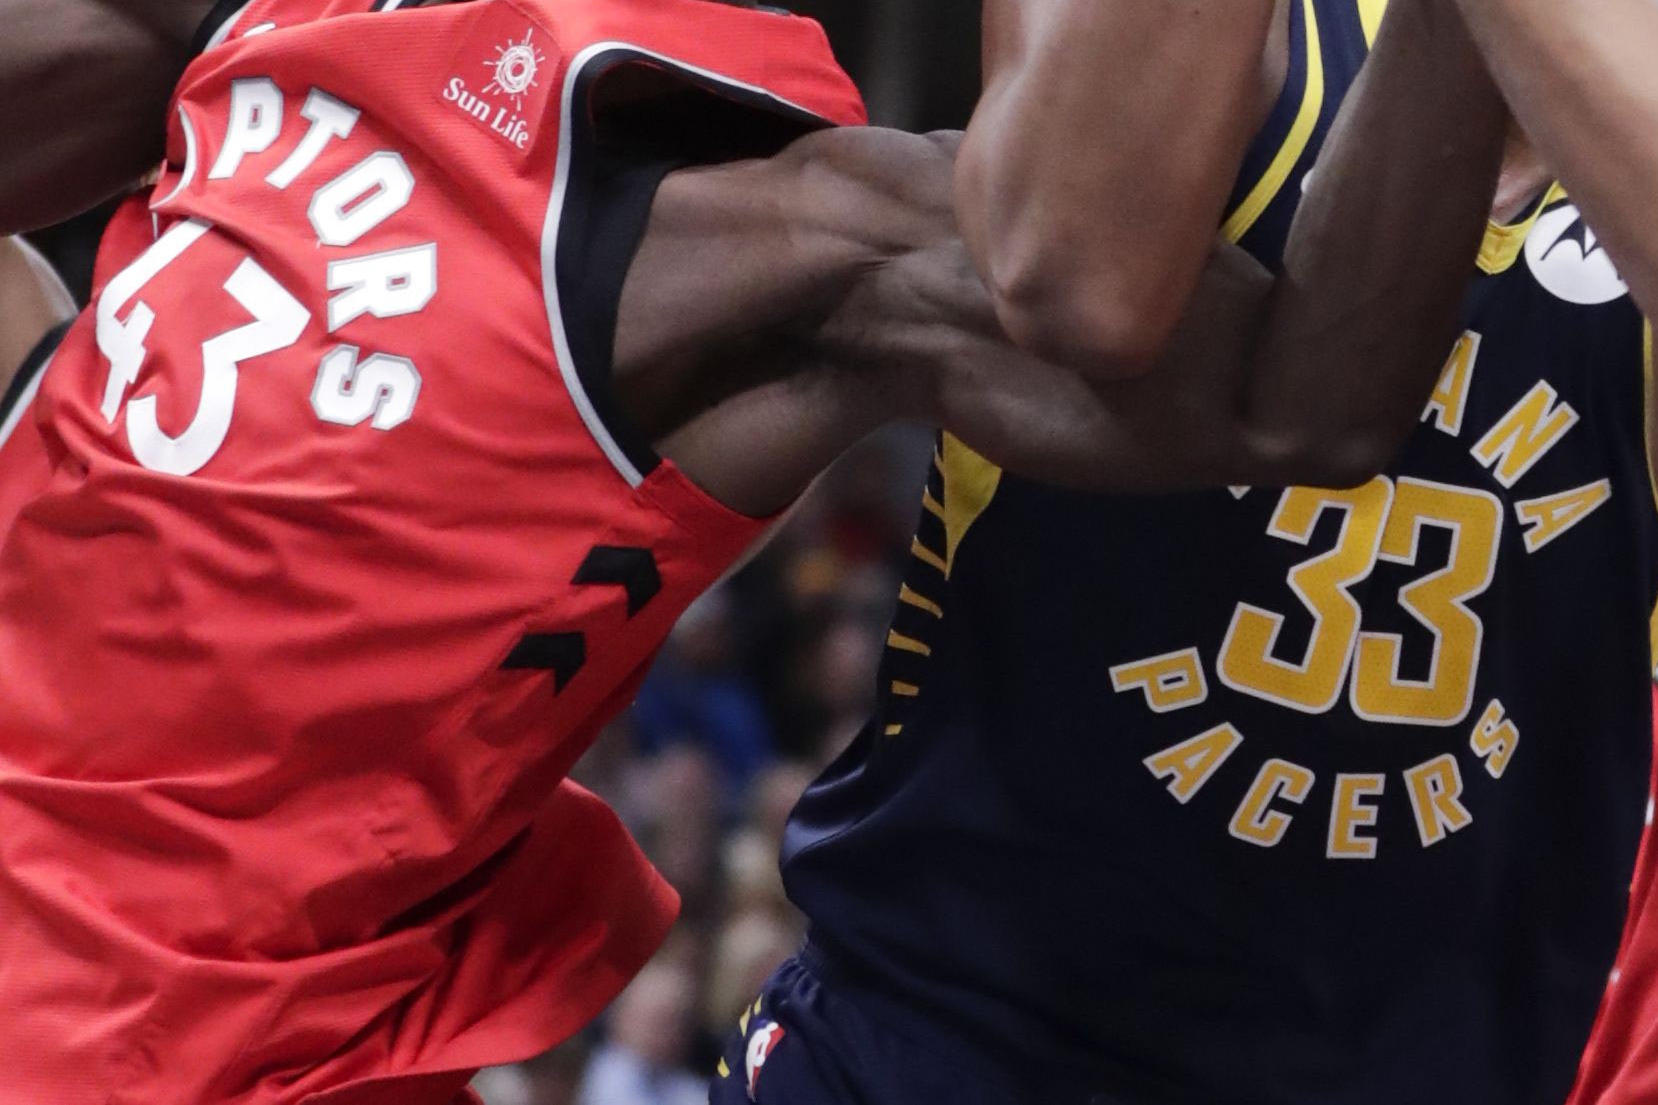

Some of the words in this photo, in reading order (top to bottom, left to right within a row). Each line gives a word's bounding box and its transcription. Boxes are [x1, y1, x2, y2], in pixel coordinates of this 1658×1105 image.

[442, 77, 491, 123] Sun
[490, 106, 530, 149] Life
[94, 215, 312, 479] 43
[206, 73, 438, 433] PTORS
[1215, 473, 1504, 728] 33
[1108, 645, 1520, 860] PACERS
